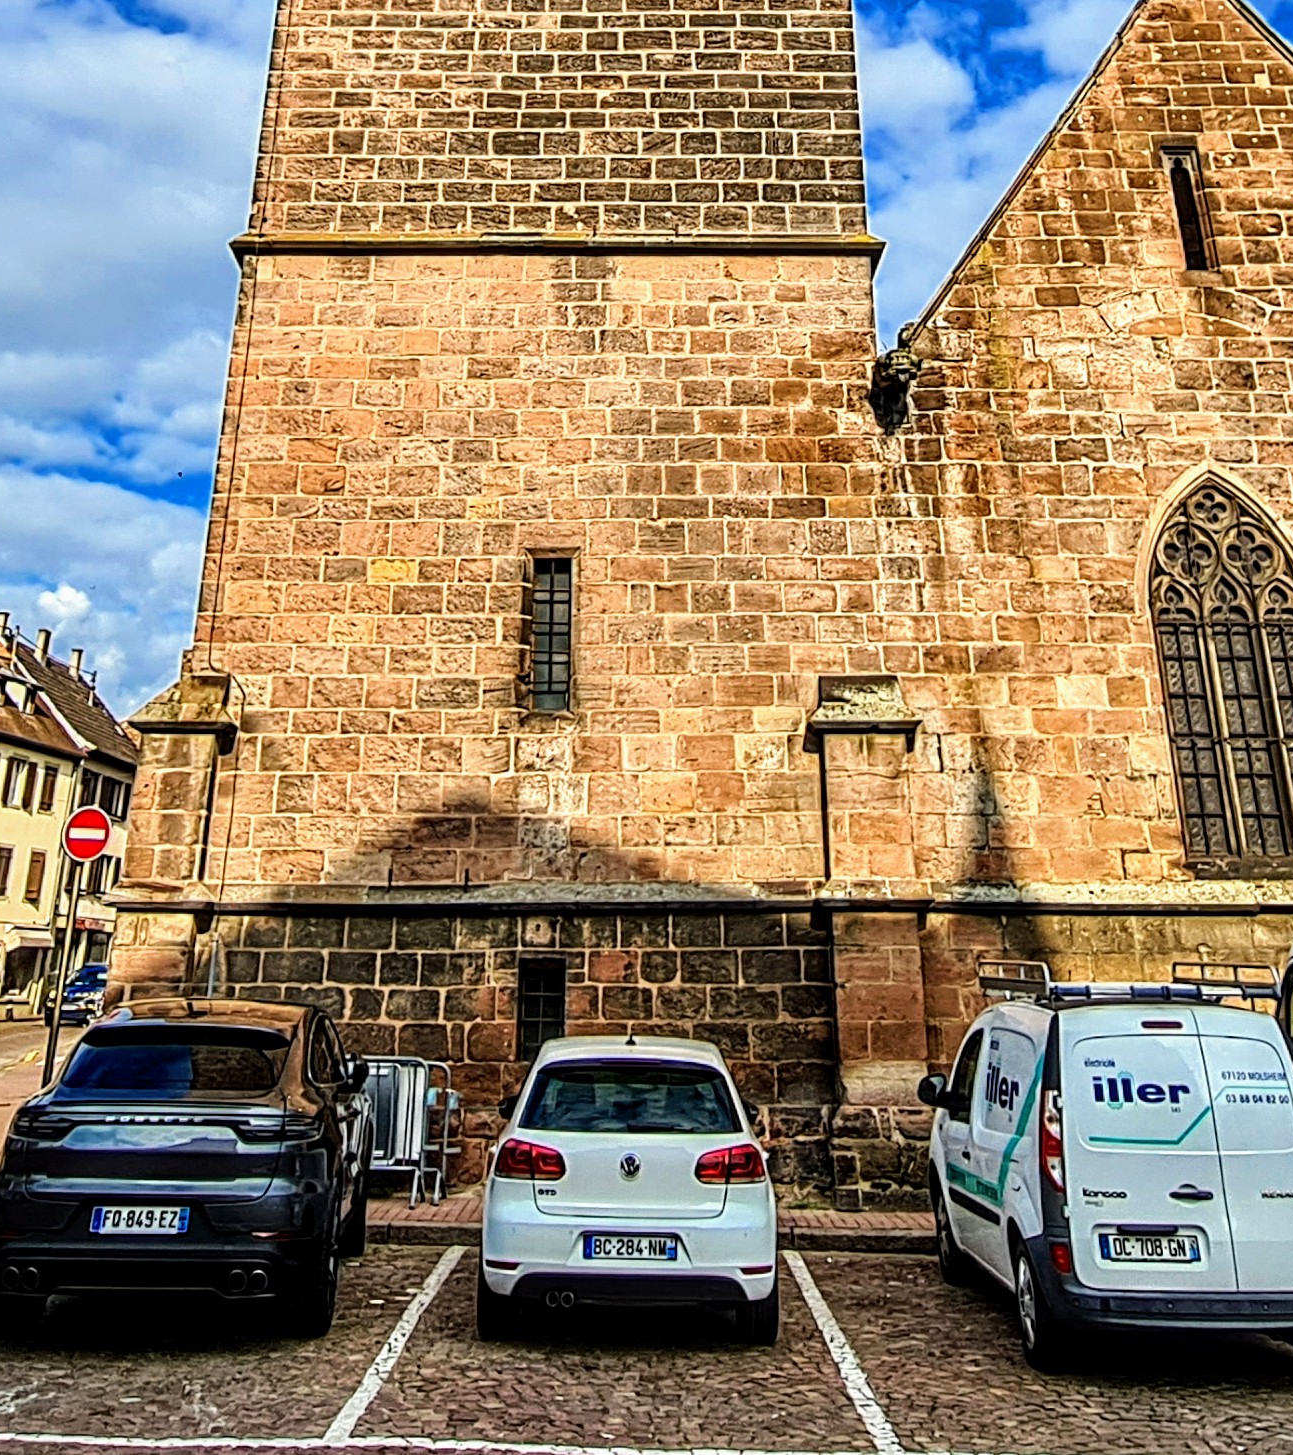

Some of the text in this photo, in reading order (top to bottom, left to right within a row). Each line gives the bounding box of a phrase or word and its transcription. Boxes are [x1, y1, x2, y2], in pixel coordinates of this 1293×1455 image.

[1222, 1071, 1286, 1081] 67120 MOLSHEIM
[986, 1062, 1019, 1111] iller
[1092, 1076, 1190, 1104] iller
[1225, 1094, 1237, 1103] 03
[1253, 1095, 1264, 1104] 04
[1266, 1095, 1277, 1104] 82
[1279, 1095, 1290, 1104] 00
